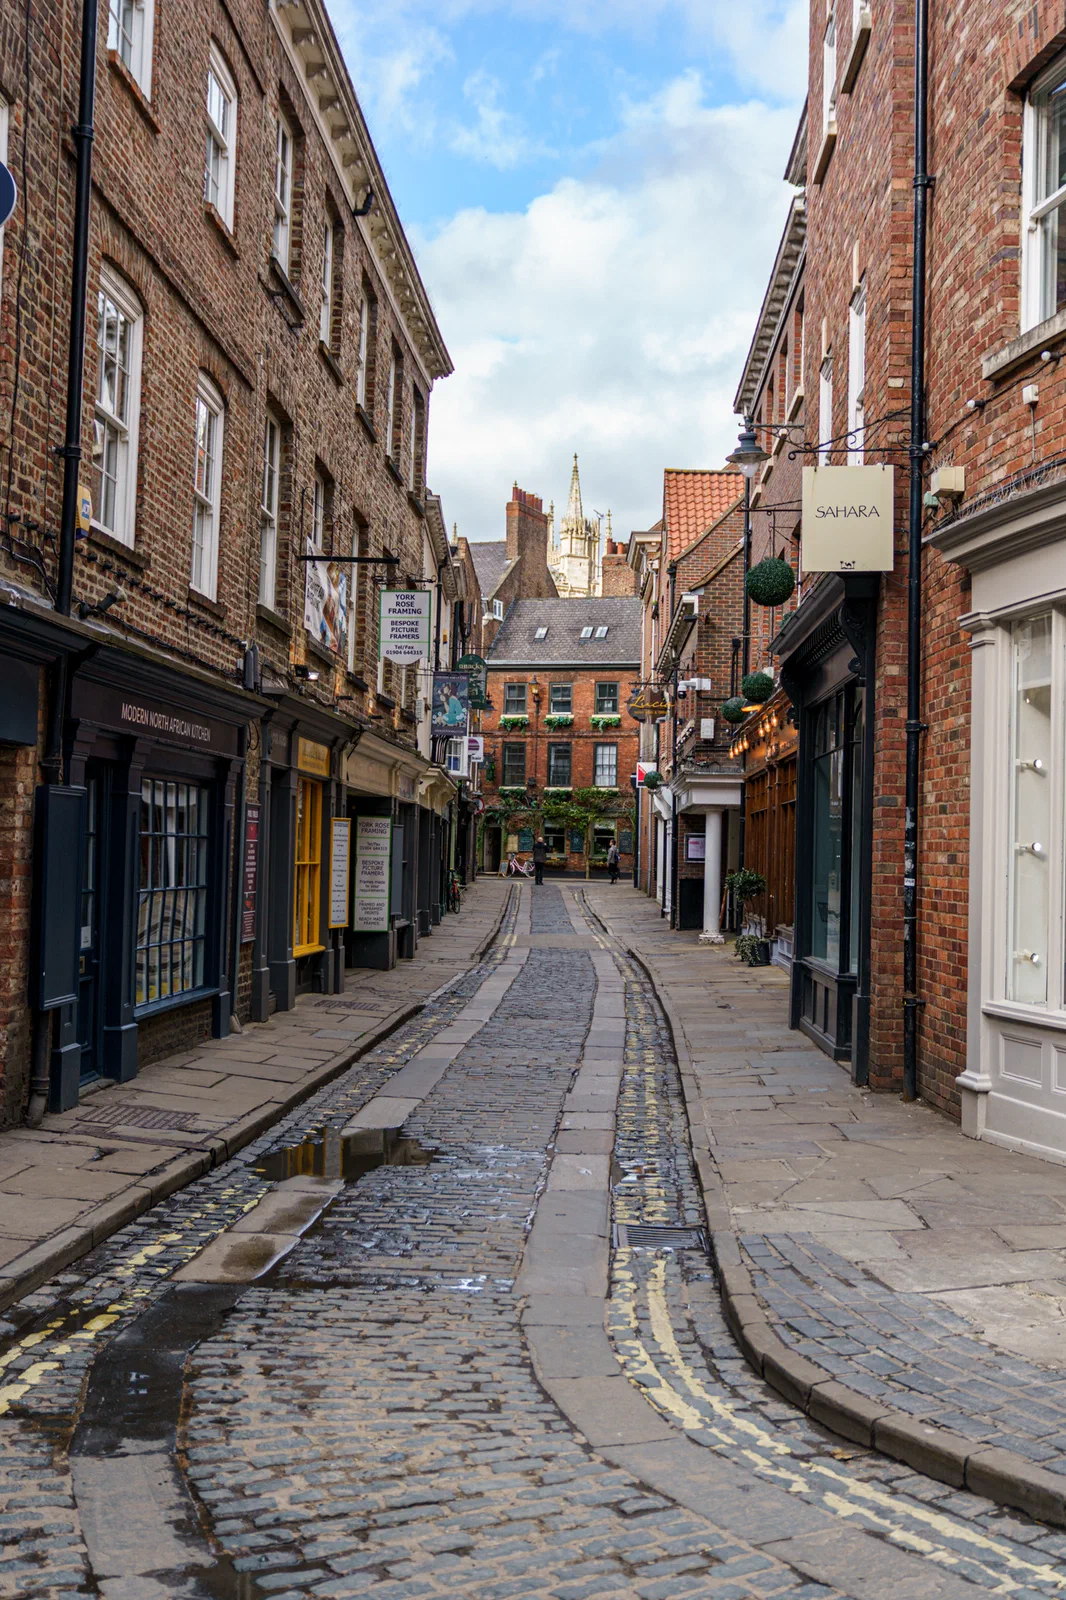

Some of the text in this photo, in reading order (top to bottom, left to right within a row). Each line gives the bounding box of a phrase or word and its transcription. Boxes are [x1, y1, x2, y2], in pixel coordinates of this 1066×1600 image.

[815, 505, 880, 518] SAHARA
[121, 702, 211, 742] MODERN NORTH AFRICAN KITCHEN
